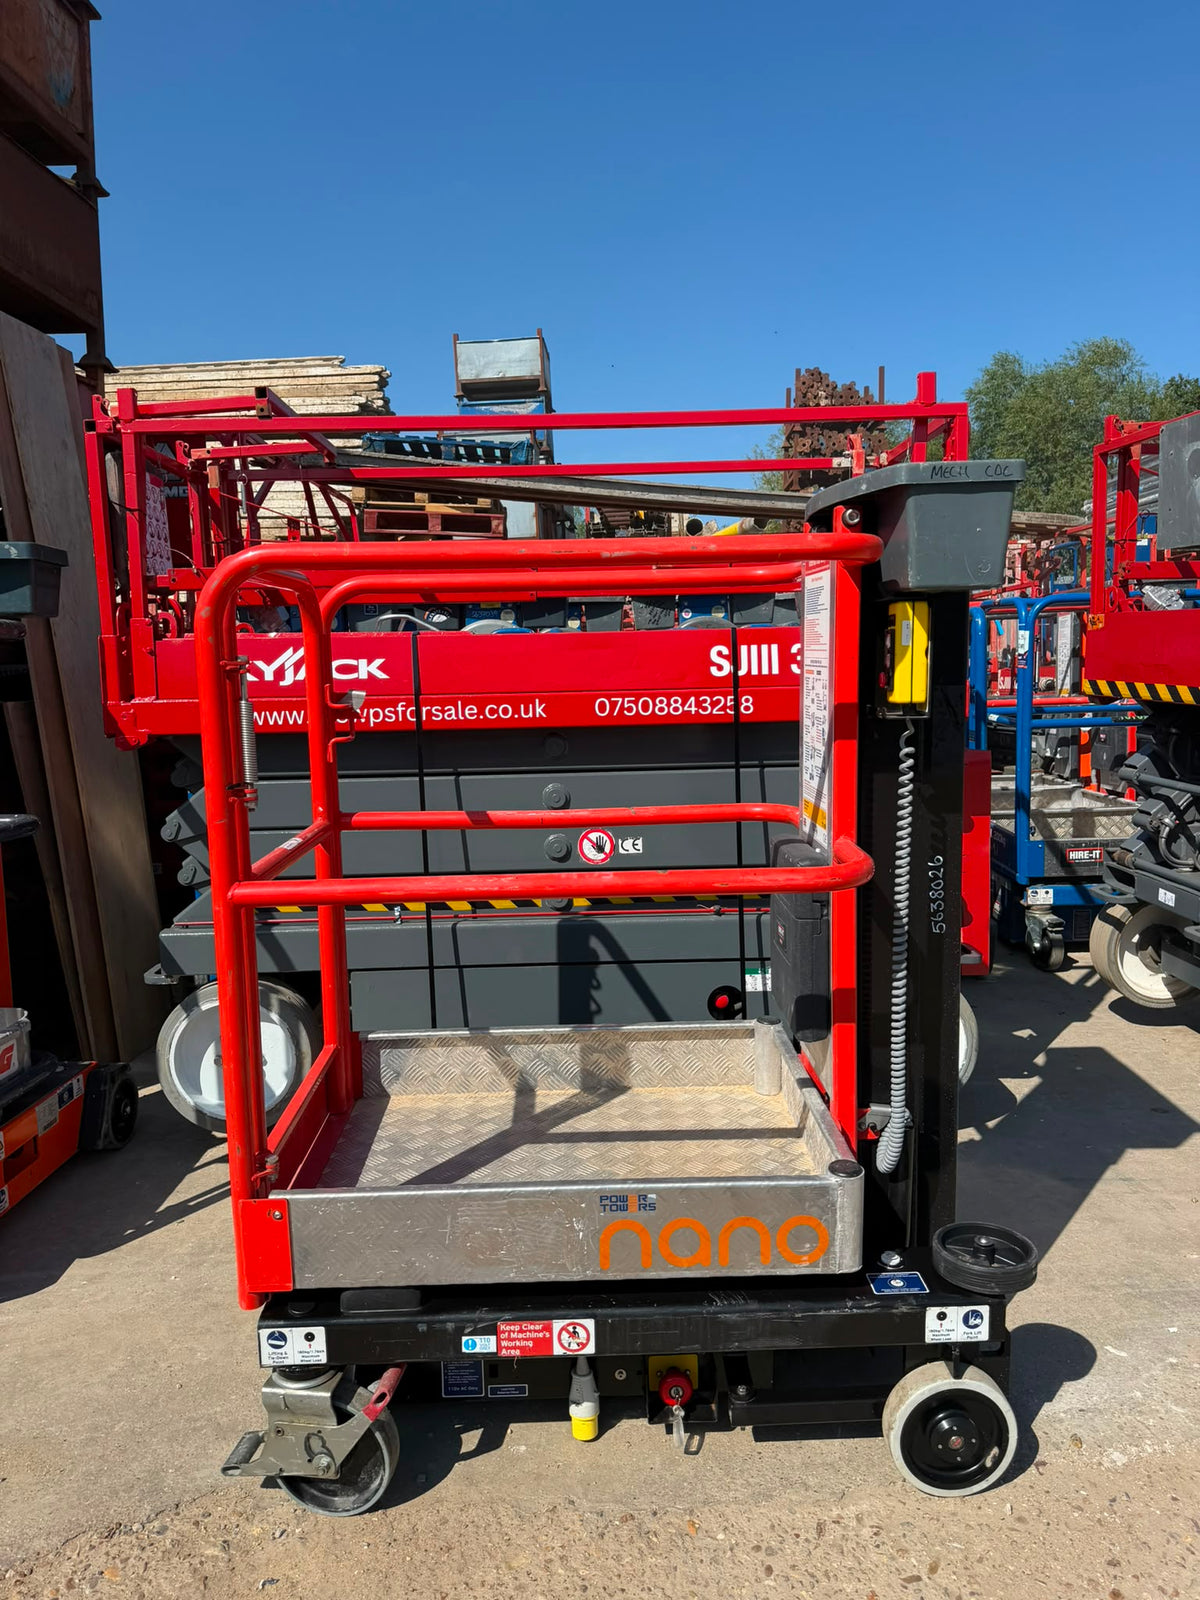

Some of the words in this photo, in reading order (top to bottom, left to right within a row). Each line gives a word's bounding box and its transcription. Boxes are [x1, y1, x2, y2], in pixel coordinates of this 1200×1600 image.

[709, 643, 779, 677] SJIII
[594, 695, 754, 717] 07508843258
[620, 838, 641, 852] CE
[1069, 850, 1101, 860] HIRE-IT
[927, 855, 946, 934] 5638026
[600, 1215, 829, 1270] nano
[500, 1323, 519, 1332] Keep
[522, 1322, 543, 1331] Clear
[500, 1332, 509, 1340] of
[510, 1330, 550, 1339] Machine's
[501, 1339, 534, 1348] Working
[501, 1347, 521, 1356] Area
